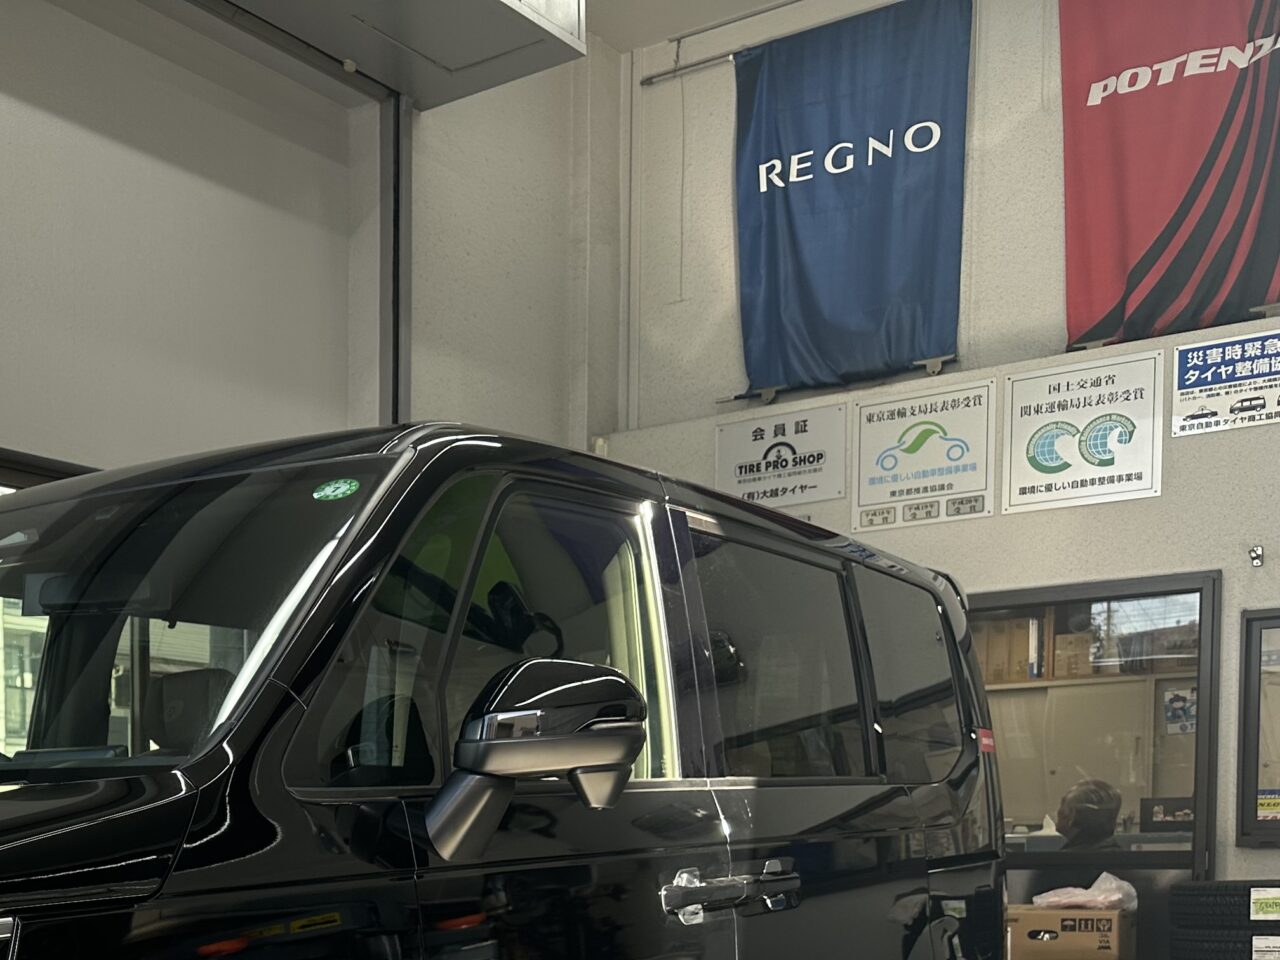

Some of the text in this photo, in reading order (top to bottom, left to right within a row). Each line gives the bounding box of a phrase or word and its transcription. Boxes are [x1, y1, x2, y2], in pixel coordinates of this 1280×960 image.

[1086, 33, 1280, 106] POTENZ
[758, 121, 941, 193] REGNO
[1048, 374, 1117, 395] 国土交通省
[865, 394, 983, 424] 東京運輸支局長表彰受賞
[1020, 387, 1145, 418] 関東運輸局長表彰受賞
[752, 419, 809, 442] 会員証
[738, 462, 762, 476] TIRE
[765, 458, 789, 472] PRO
[791, 452, 824, 467] SHOP
[1018, 472, 1143, 496] 環境に優しい自動車整備事業場
